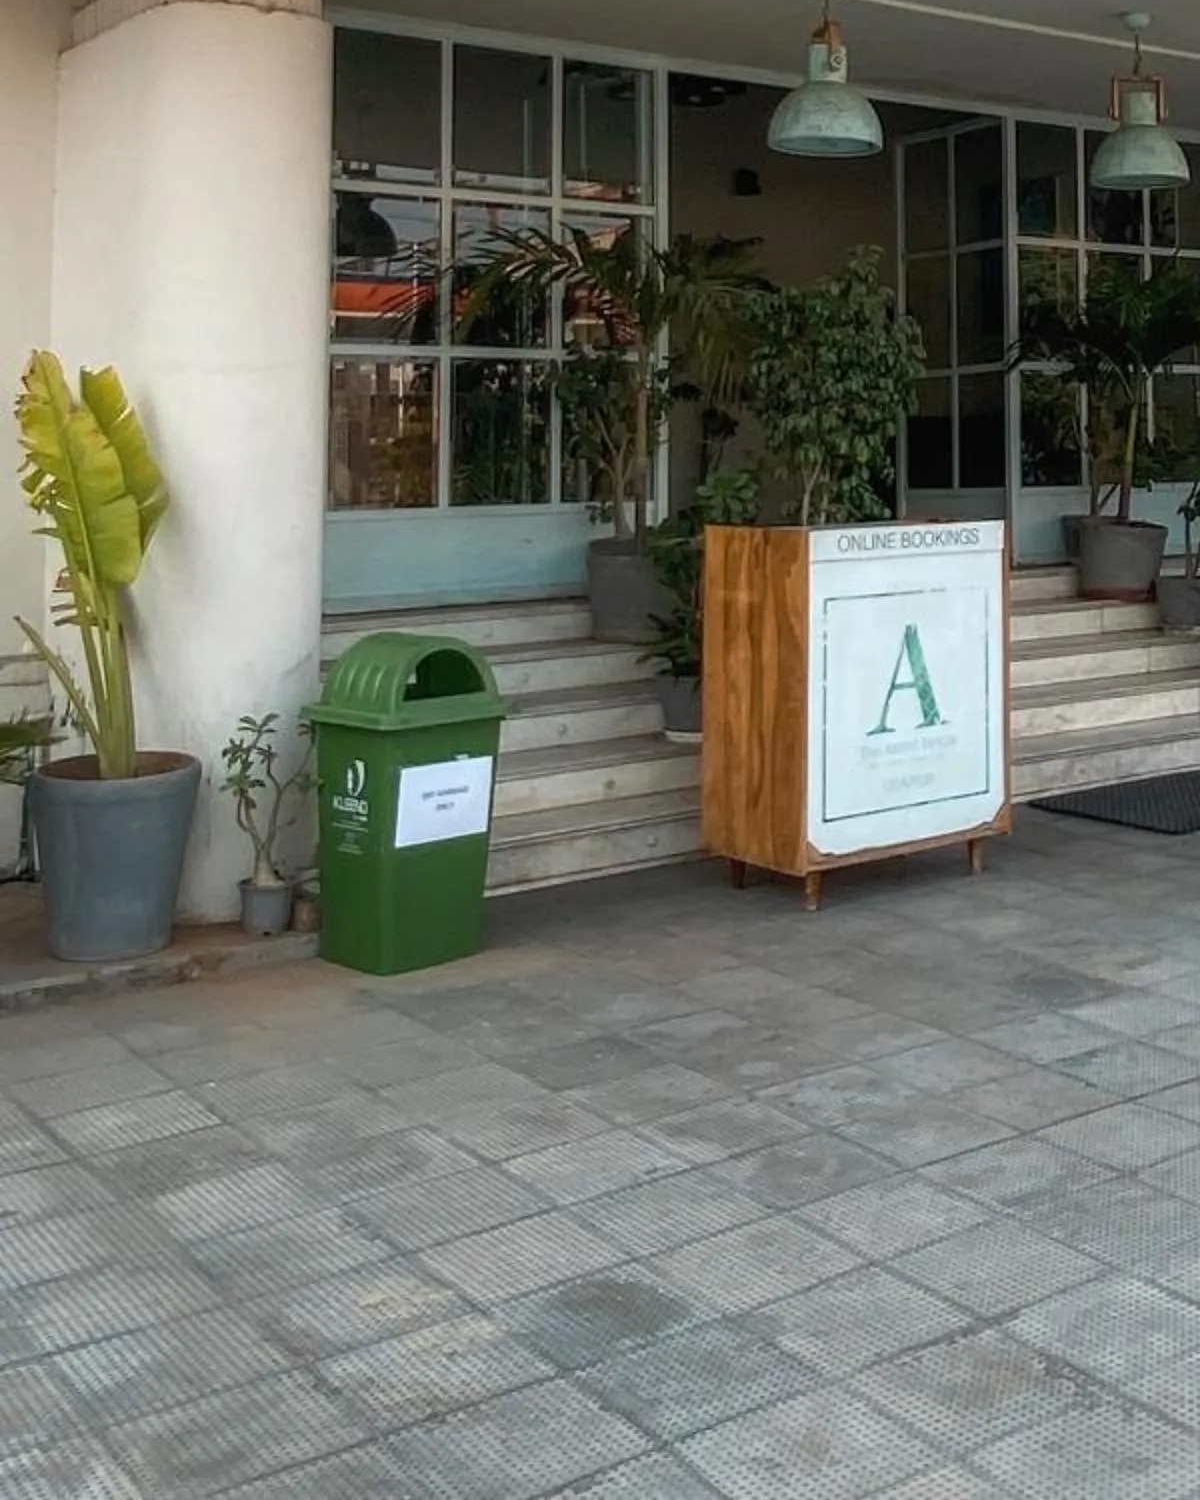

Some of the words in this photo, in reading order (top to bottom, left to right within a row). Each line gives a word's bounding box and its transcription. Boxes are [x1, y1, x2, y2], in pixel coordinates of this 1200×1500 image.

[837, 531, 897, 552] ONLINE
[901, 527, 981, 549] BOOKINGS
[866, 623, 949, 737] A
